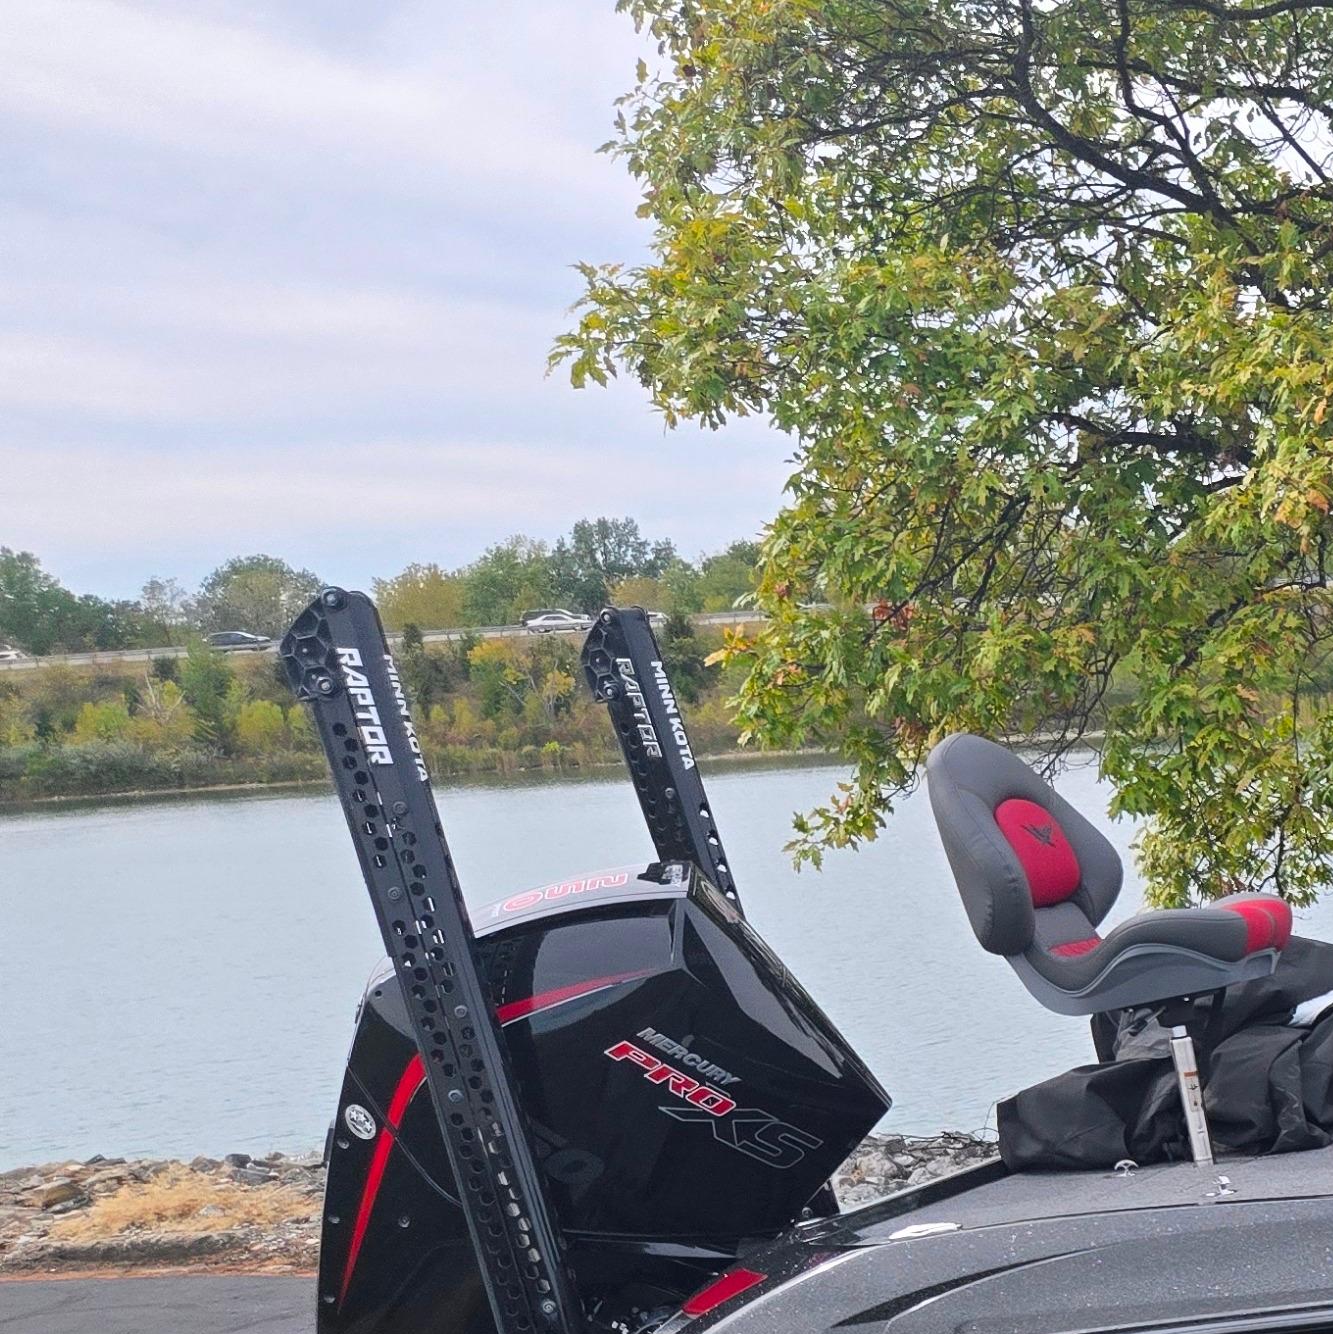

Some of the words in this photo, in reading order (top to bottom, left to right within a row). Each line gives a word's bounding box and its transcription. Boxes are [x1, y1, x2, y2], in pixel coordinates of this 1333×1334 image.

[336, 648, 394, 765] RAPTOR
[383, 654, 410, 717] MINN
[403, 720, 429, 782] KOTA
[615, 658, 663, 758] RAPTOR
[650, 661, 678, 714] MINN
[669, 717, 695, 770] KOTA
[603, 1040, 737, 1117] PRO
[636, 1027, 742, 1086] MERCURY
[658, 1105, 824, 1170] XS
